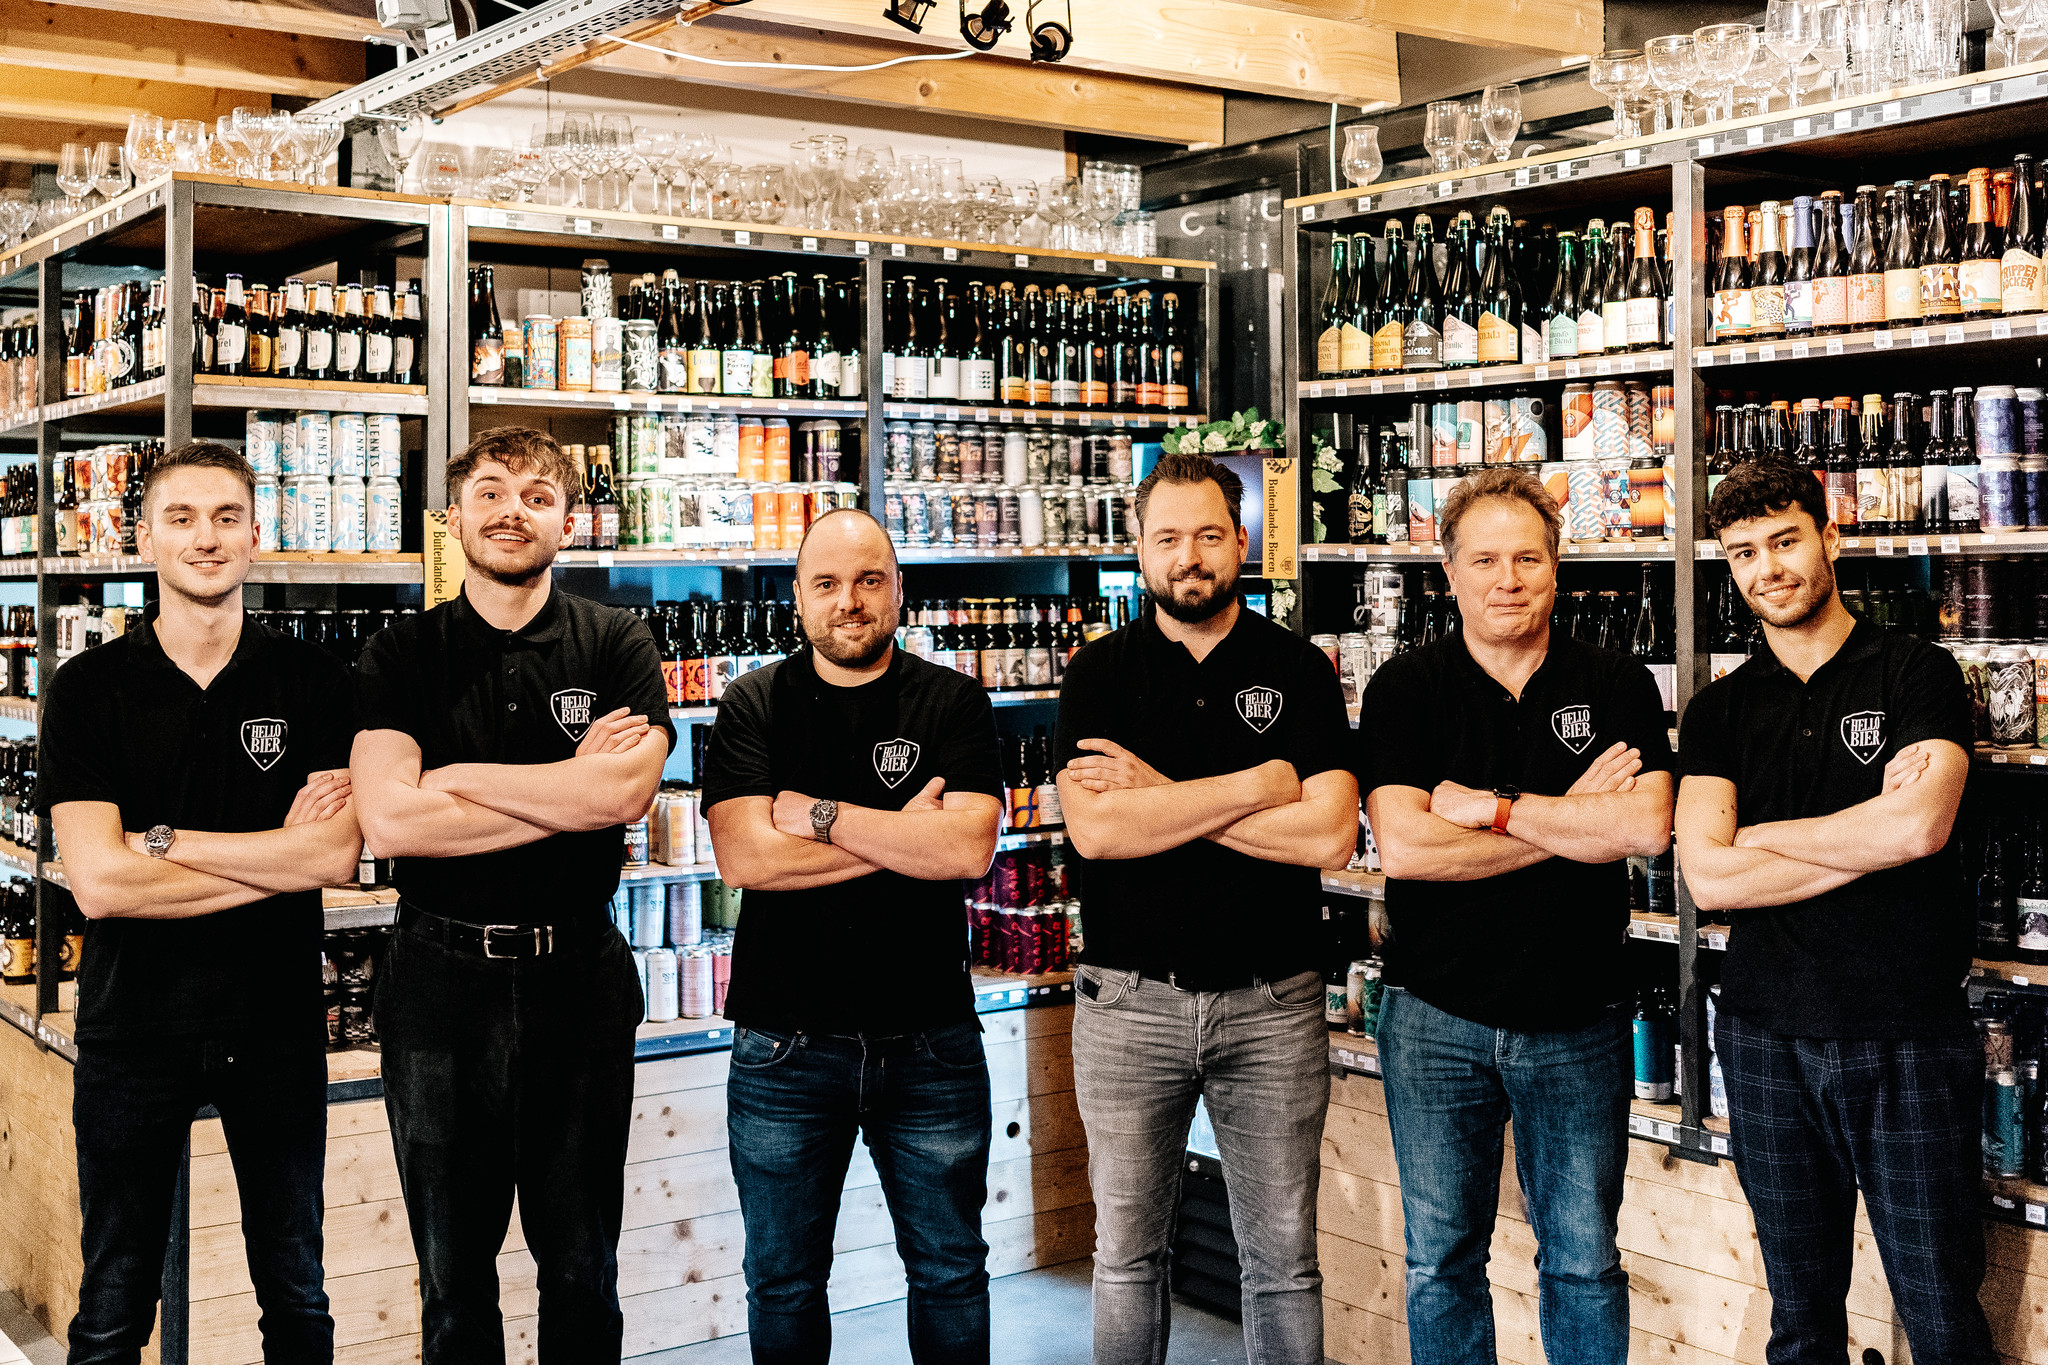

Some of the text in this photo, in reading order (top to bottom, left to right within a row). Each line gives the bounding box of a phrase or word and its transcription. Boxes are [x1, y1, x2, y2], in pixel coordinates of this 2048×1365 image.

[317, 420, 328, 466] TENNIS
[356, 422, 365, 468] TENNIS
[369, 421, 380, 468] TENNIS
[315, 496, 326, 542] TENNIS
[389, 496, 399, 542] TENNIS
[1268, 479, 1279, 573] Buitenlandse Bieren
[561, 695, 591, 709] HELLO
[1245, 692, 1273, 705] HELLO
[561, 708, 590, 724] BIER
[1245, 704, 1273, 719] BIER
[1561, 709, 1590, 725] HELLO
[251, 724, 281, 738] HELLO
[1562, 722, 1591, 738] BIER
[1851, 716, 1880, 731] HELLO
[250, 737, 280, 753] BIER
[1850, 730, 1880, 747] BIER
[882, 745, 910, 758] HELLO
[880, 757, 908, 772] BIER
